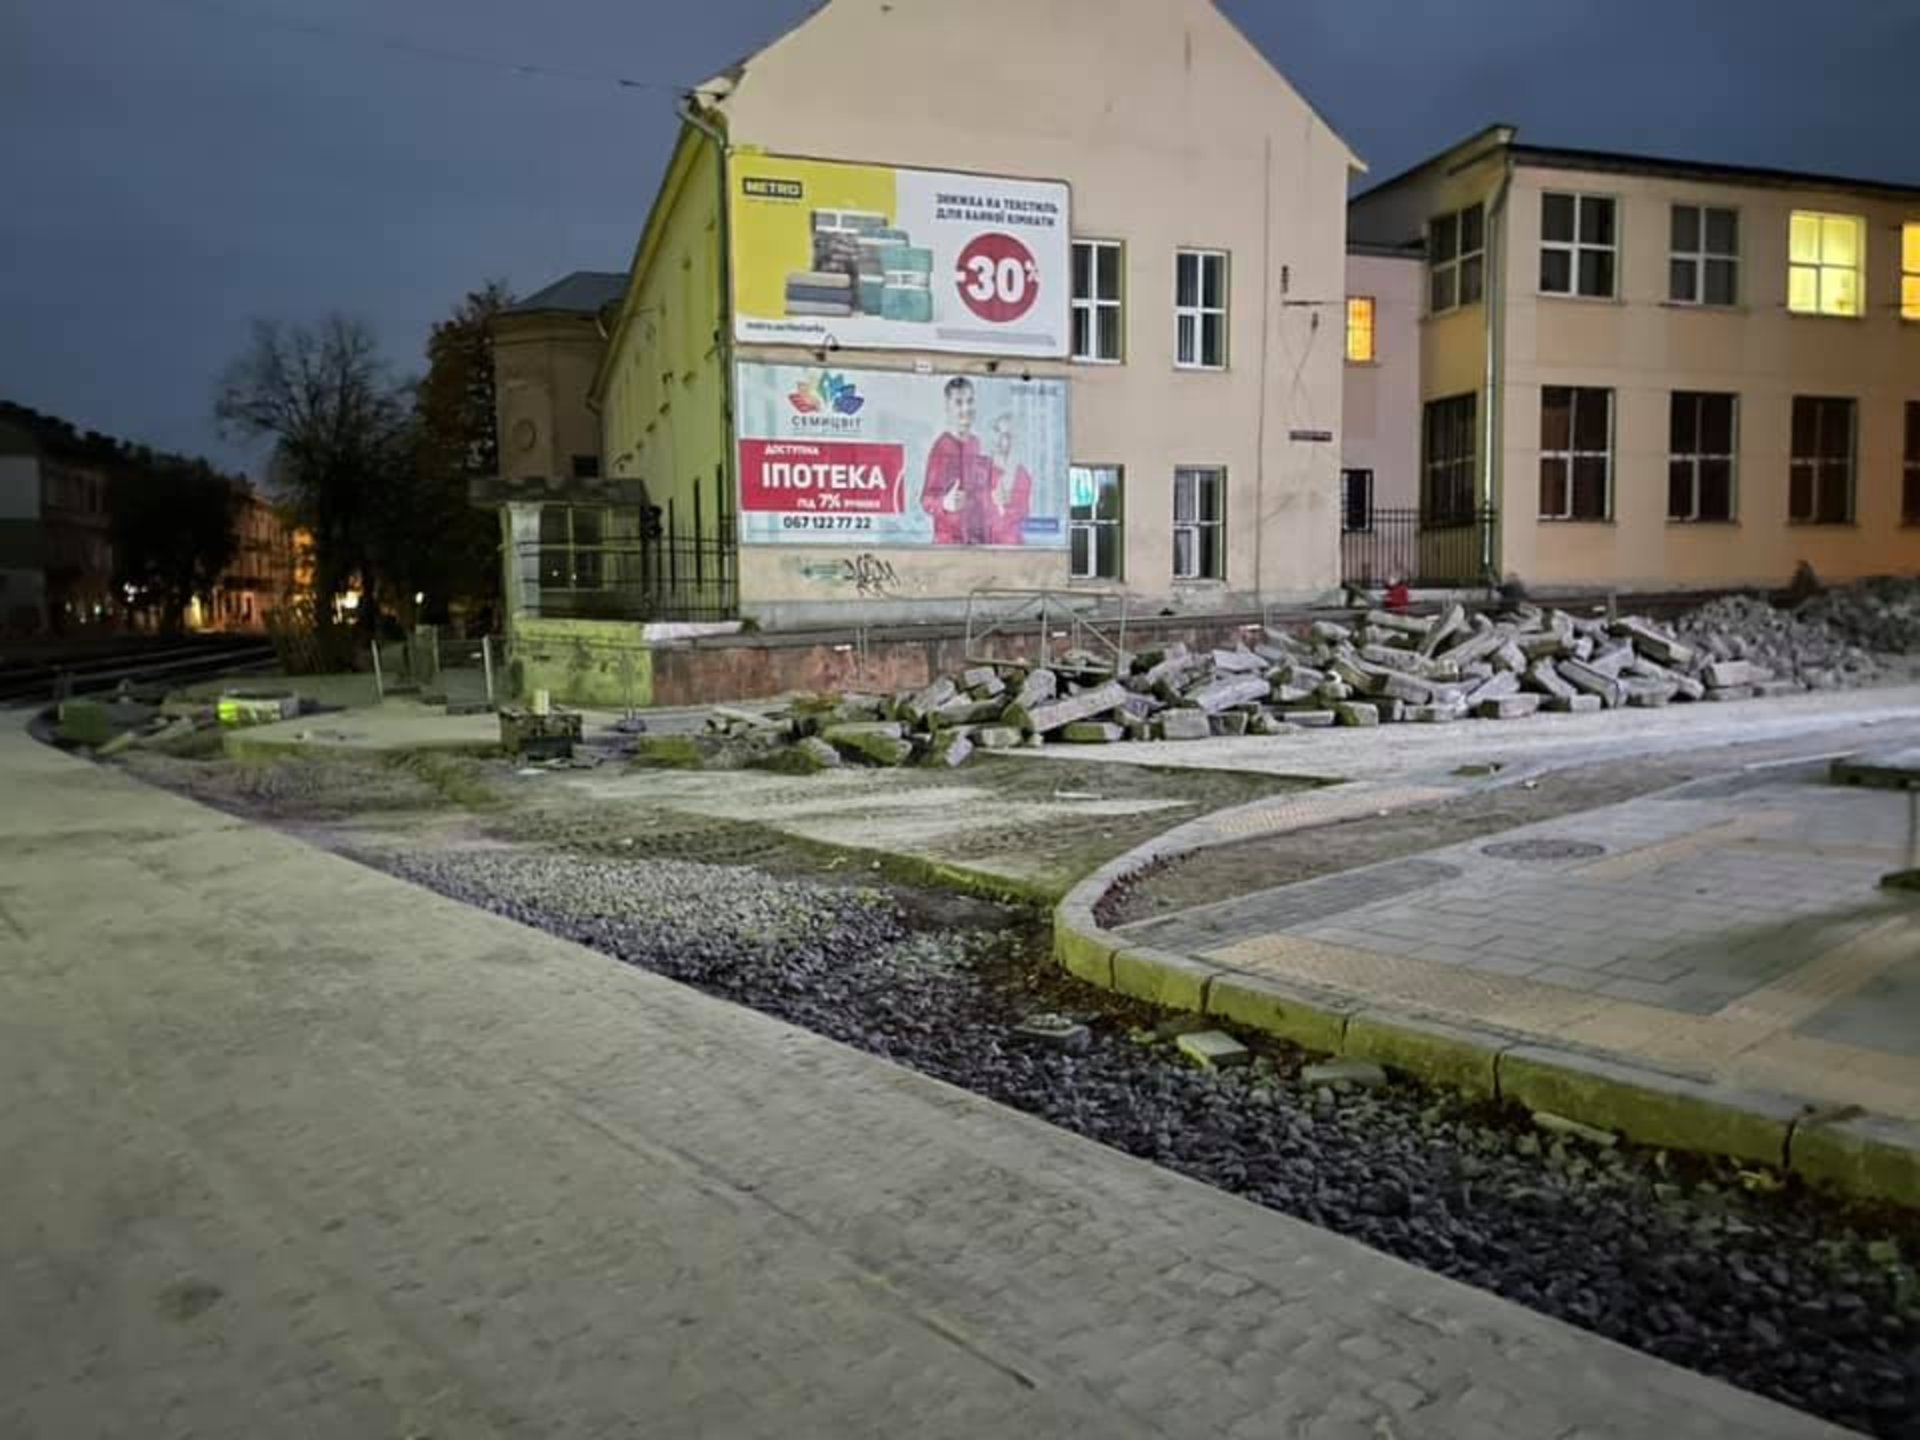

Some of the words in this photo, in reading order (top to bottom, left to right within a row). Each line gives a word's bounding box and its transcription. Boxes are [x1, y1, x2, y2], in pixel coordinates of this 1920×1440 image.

[745, 181, 800, 196] METRO
[936, 193, 983, 207] ЗНИЖКА
[986, 198, 1001, 208] НА
[1003, 199, 1058, 214] ТЕКСТИЛЬ
[936, 208, 962, 219] ДЛЯ
[965, 209, 1004, 224] ВАННОЇ
[1007, 214, 1055, 226] КІМНАТИ
[791, 415, 862, 429] СЕМИЦВІТ
[762, 463, 887, 490] ІПОТЕКА
[783, 516, 809, 528] 067
[811, 516, 834, 529] 122
[835, 517, 852, 528] 77
[855, 517, 872, 529] 22
